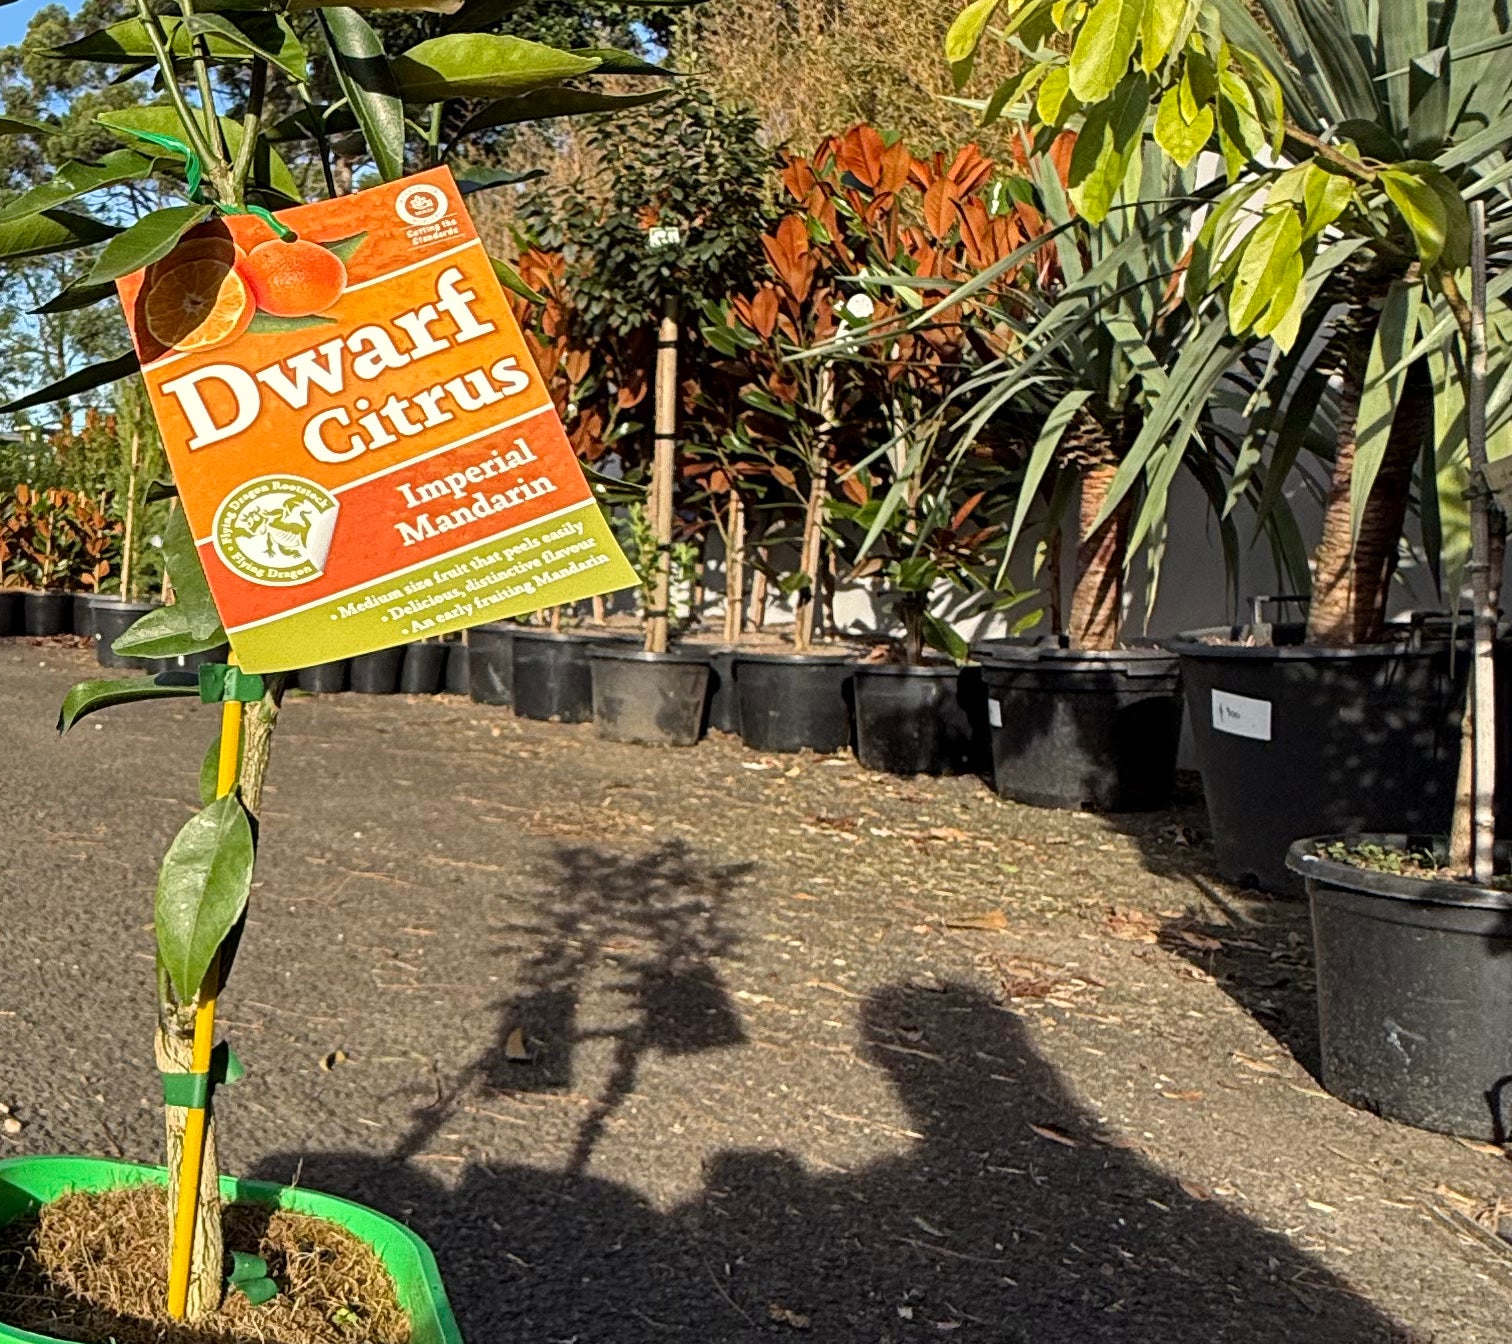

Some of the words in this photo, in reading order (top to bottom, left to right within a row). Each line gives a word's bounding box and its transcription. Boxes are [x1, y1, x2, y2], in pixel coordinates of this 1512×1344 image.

[161, 267, 496, 451] Dwarf
[303, 356, 530, 463] Citrus
[228, 484, 270, 510] Dragon
[272, 481, 329, 509] Rootstock
[396, 437, 538, 509] Imperial
[220, 511, 237, 545] Flying
[393, 476, 558, 546] Mandarin
[231, 552, 265, 578] Flying
[267, 566, 313, 580] Dragon
[337, 588, 405, 619] Medium
[403, 577, 433, 595] size
[433, 562, 469, 586] fruit
[469, 550, 503, 571] that
[503, 536, 541, 562] peels
[541, 520, 585, 544] easily
[387, 587, 466, 621] Delicious,
[465, 558, 541, 593] distinctive
[541, 537, 597, 564] flavour
[411, 617, 435, 633] An
[435, 603, 474, 624] early
[474, 581, 536, 610] fruiting
[534, 553, 610, 588] Mandarin
